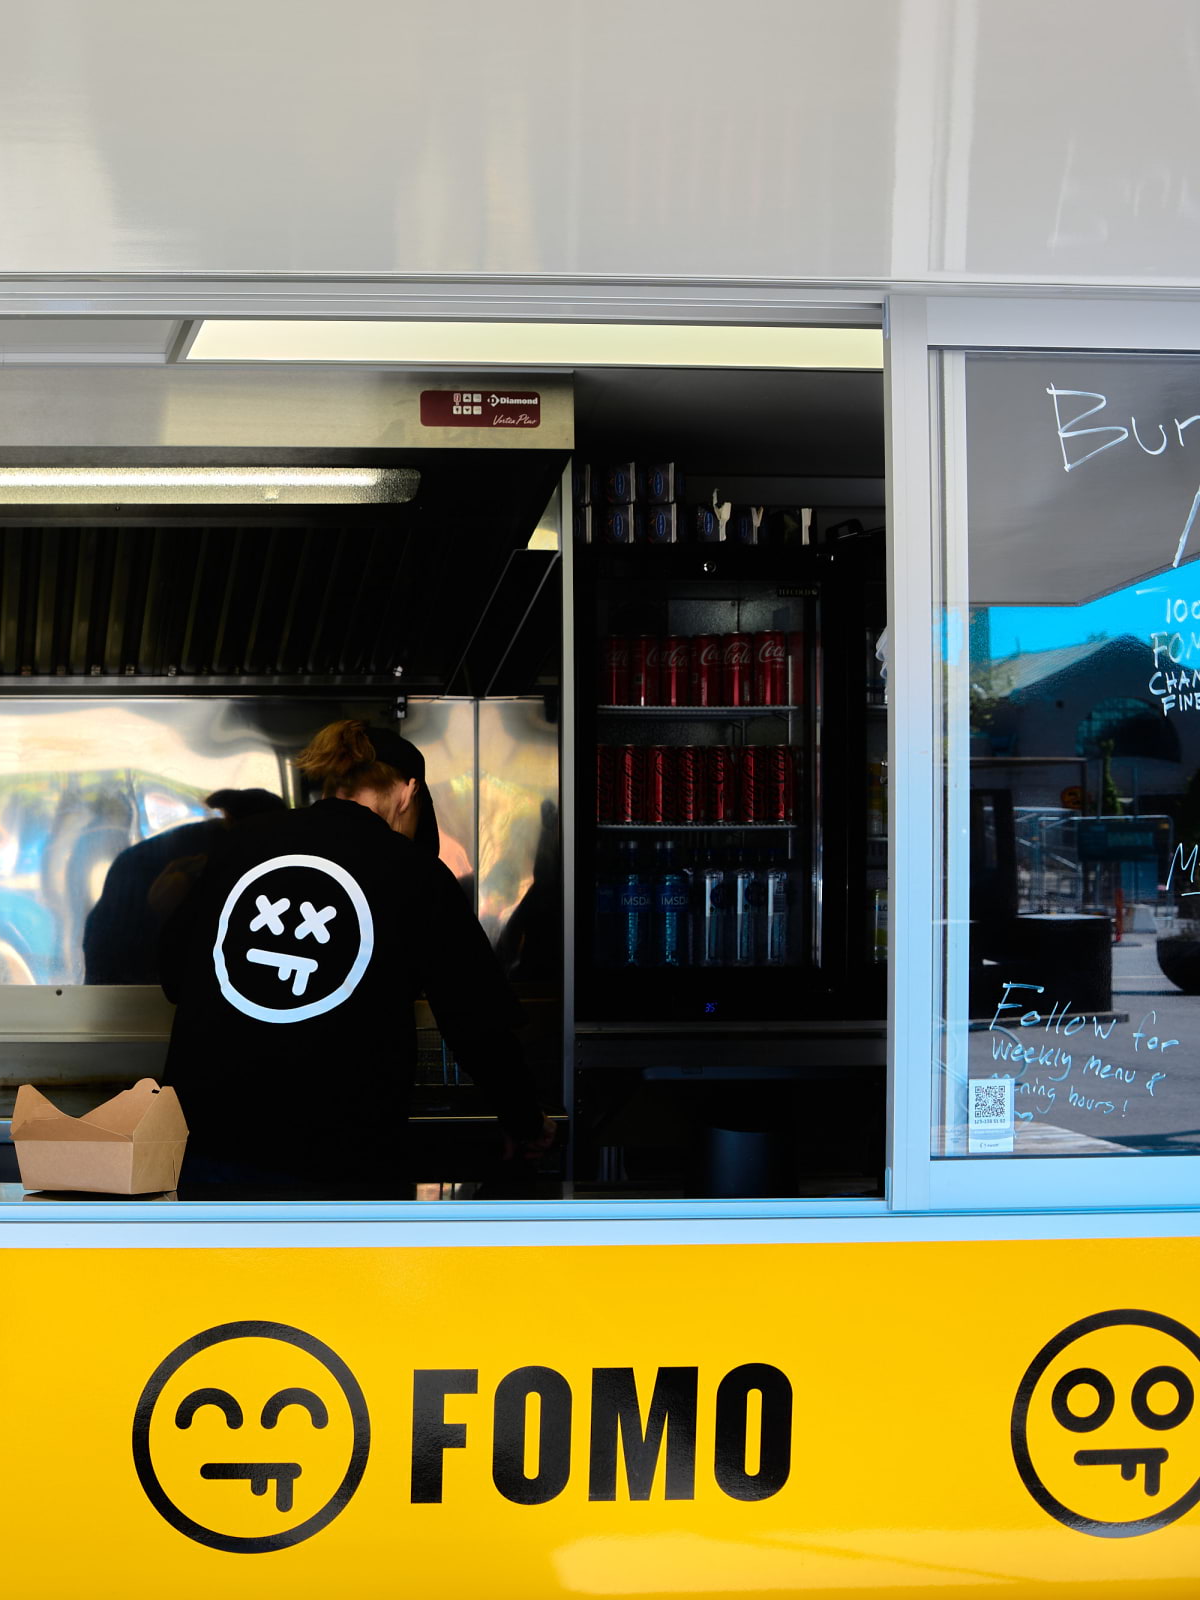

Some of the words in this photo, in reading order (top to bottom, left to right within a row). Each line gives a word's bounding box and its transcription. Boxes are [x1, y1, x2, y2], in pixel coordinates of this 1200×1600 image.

[990, 981, 1117, 1040] Follow
[1131, 1010, 1180, 1053] for
[410, 1362, 793, 1505] FOMO
